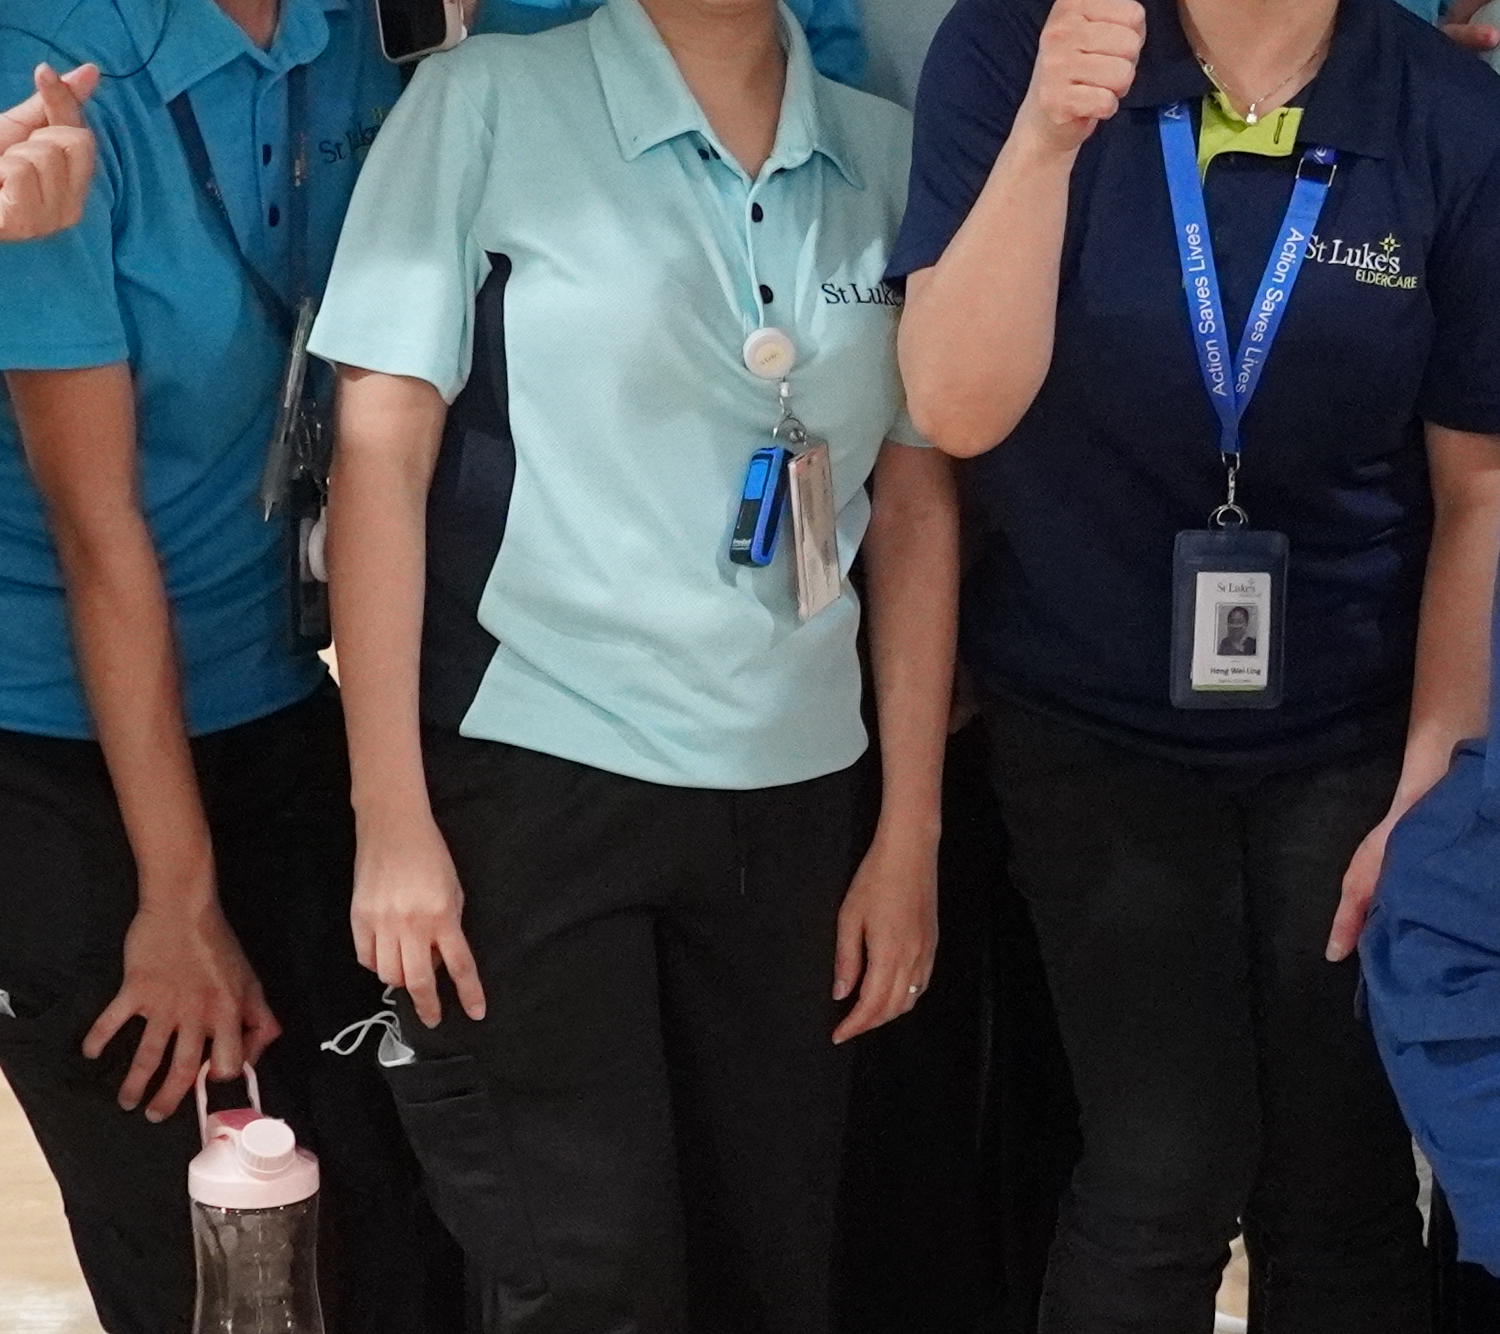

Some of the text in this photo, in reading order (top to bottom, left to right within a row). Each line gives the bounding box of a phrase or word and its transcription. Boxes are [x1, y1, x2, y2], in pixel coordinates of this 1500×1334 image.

[1304, 234, 1327, 263] St
[822, 283, 850, 304] St
[1355, 269, 1418, 290] ELDERCARE
[1186, 223, 1227, 397] Action Saves Lives
[1235, 227, 1305, 394] Action Saves Lives
